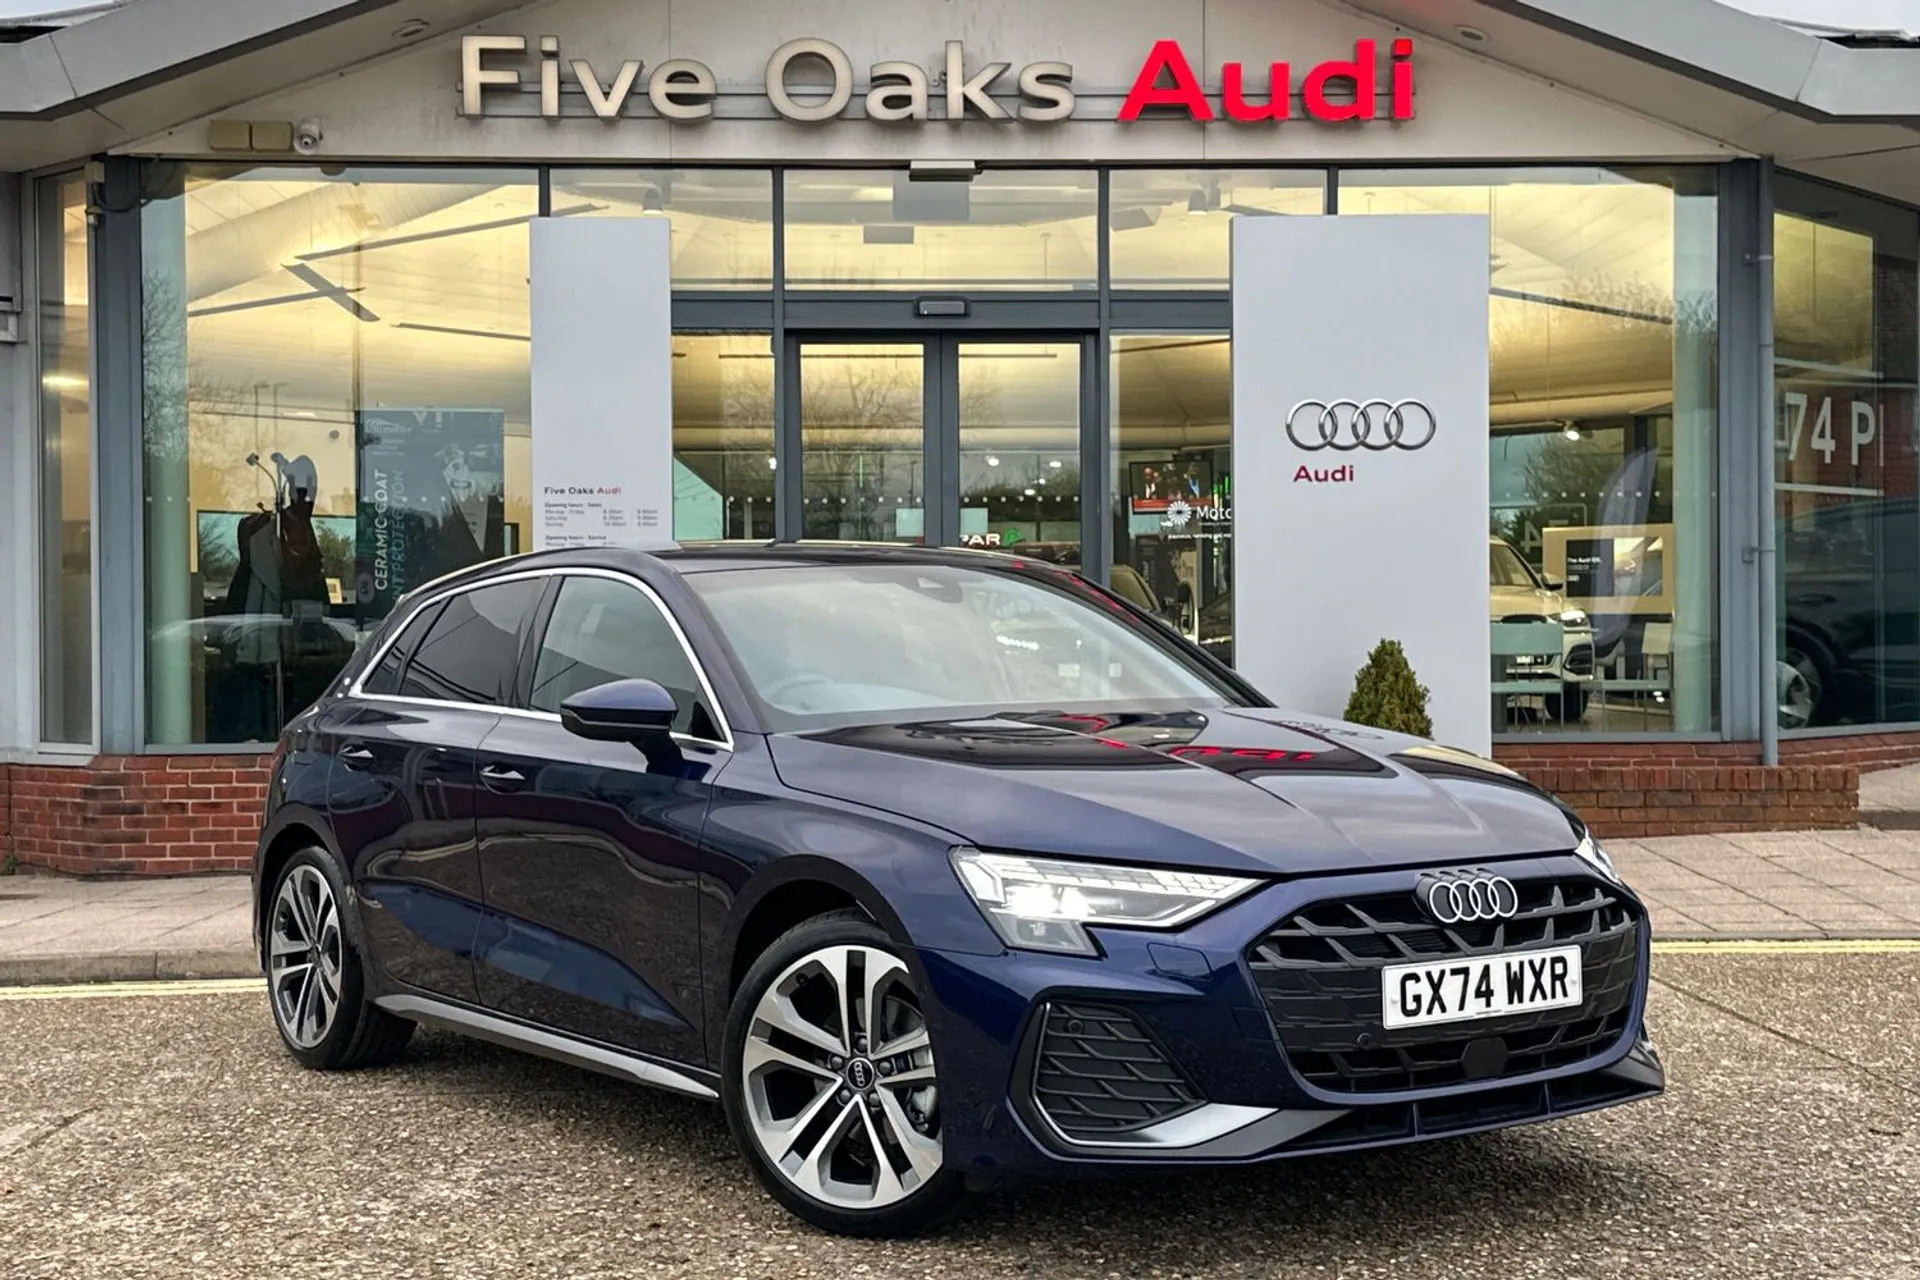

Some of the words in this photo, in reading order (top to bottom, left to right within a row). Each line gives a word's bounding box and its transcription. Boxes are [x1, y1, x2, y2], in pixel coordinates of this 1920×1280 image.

[461, 34, 717, 121] Five
[765, 37, 1075, 122] Oaks
[1117, 38, 1414, 122] Audi
[1785, 392, 1836, 464] 74
[374, 469, 388, 514] COAT
[544, 486, 566, 496] Five
[568, 486, 594, 496] Oaks
[597, 486, 622, 496] Audi
[1293, 465, 1355, 482] Audi
[374, 517, 388, 590] CERAMIC
[1400, 963, 1494, 1018] GX74
[1506, 955, 1569, 1006] WXR
